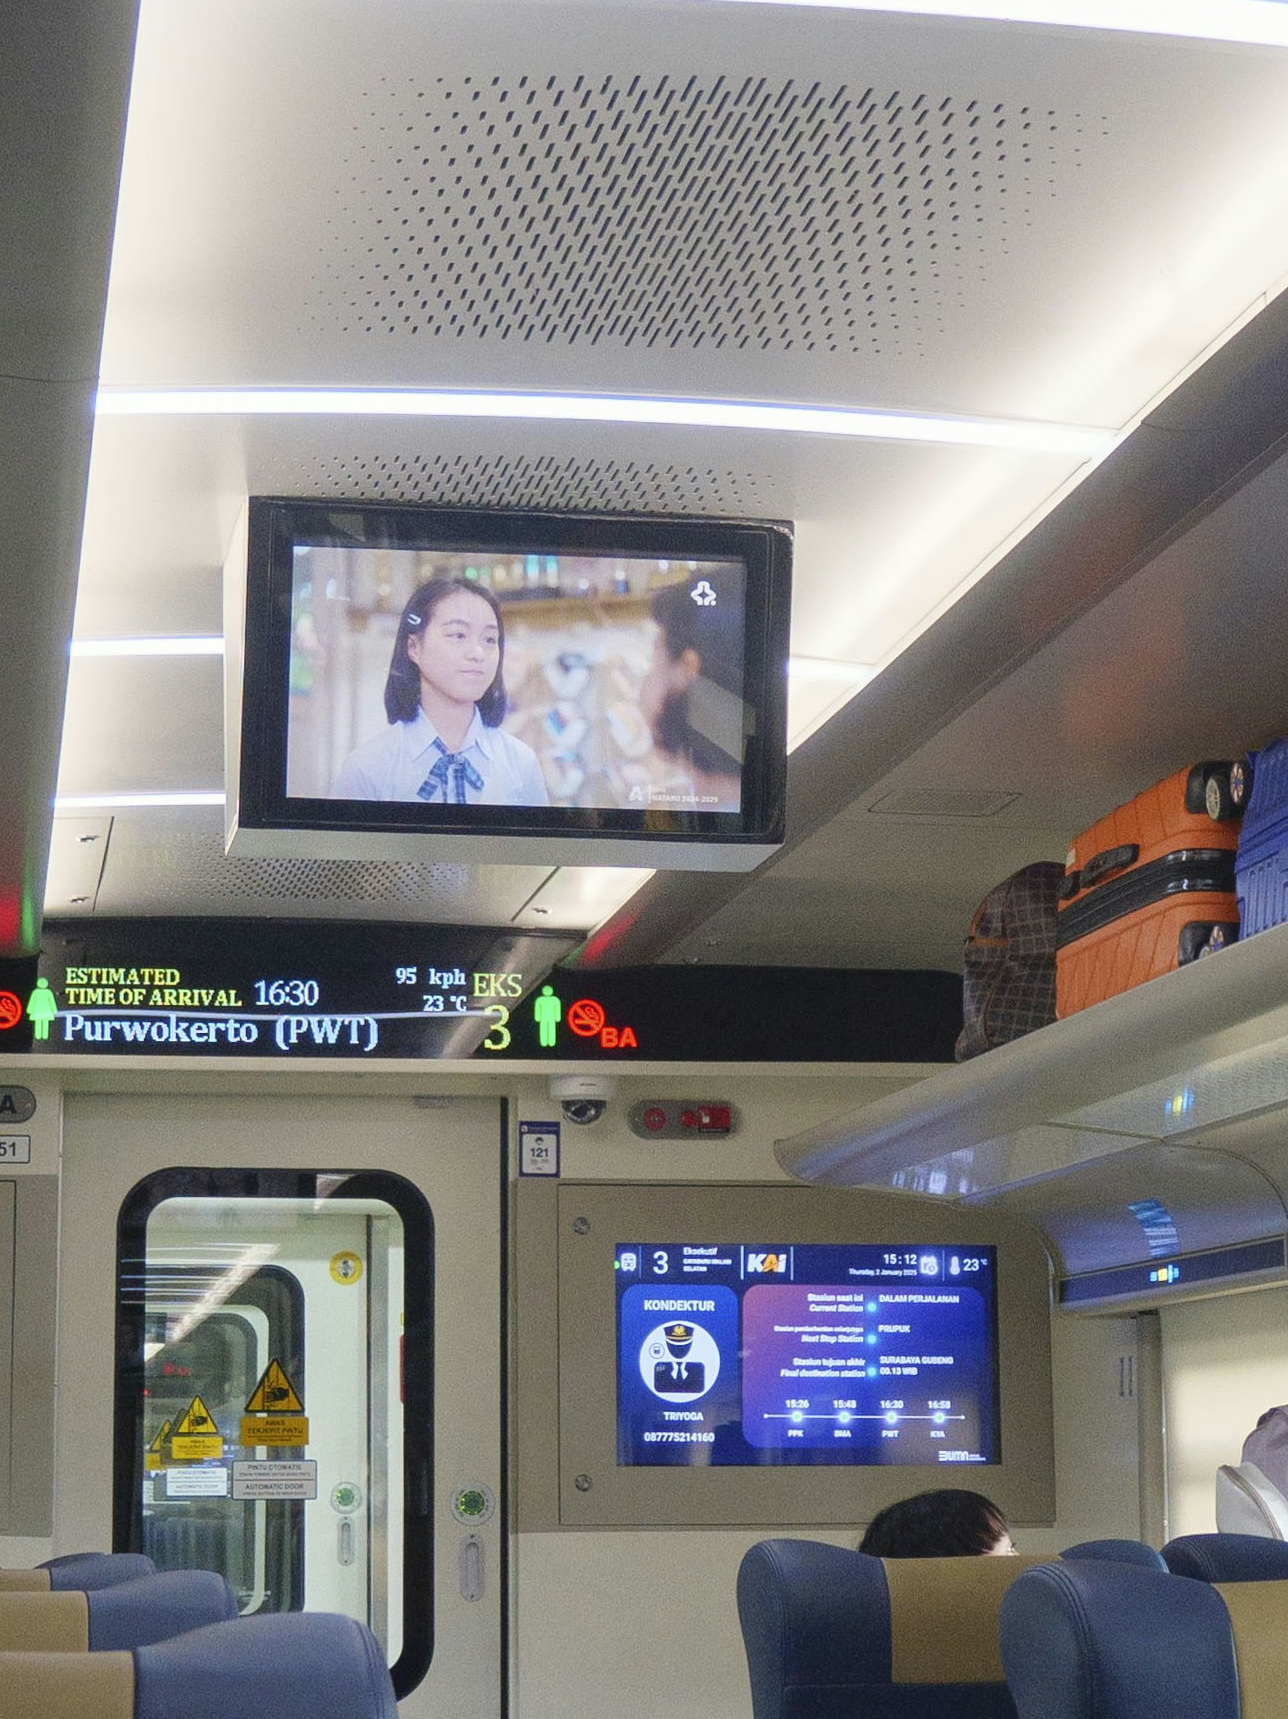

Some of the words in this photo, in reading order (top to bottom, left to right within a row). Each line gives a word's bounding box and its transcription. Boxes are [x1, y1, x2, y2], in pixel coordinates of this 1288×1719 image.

[65, 968, 180, 986] ESTIMATED
[395, 967, 417, 984] 95
[429, 969, 466, 989] kph
[254, 979, 320, 1007] 16:30
[473, 973, 522, 998] EKS
[65, 988, 115, 1006] TIME
[119, 989, 146, 1006] OF
[149, 989, 242, 1007] ARRIVAL
[423, 995, 444, 1012] 23
[64, 1014, 258, 1043] Purwokerto
[275, 1015, 378, 1051] (PWT)
[484, 1004, 511, 1051] 3
[600, 1027, 638, 1048] BA
[530, 1147, 549, 1158] 121
[653, 1251, 669, 1274] 3
[747, 1253, 787, 1273] KAI
[963, 1258, 979, 1271] 23
[644, 1300, 715, 1312] KONDEKTUR
[879, 1294, 907, 1303] DALAM
[908, 1295, 960, 1303] PERJALANAN
[839, 1304, 864, 1312] Station
[878, 1325, 911, 1333] PRUPUK
[837, 1334, 864, 1343] Station
[879, 1356, 921, 1365] SURABAYA
[780, 1368, 800, 1377] Final
[840, 1369, 866, 1378] station
[785, 1400, 809, 1409] 15:26
[663, 1412, 704, 1421] TRIYOGA
